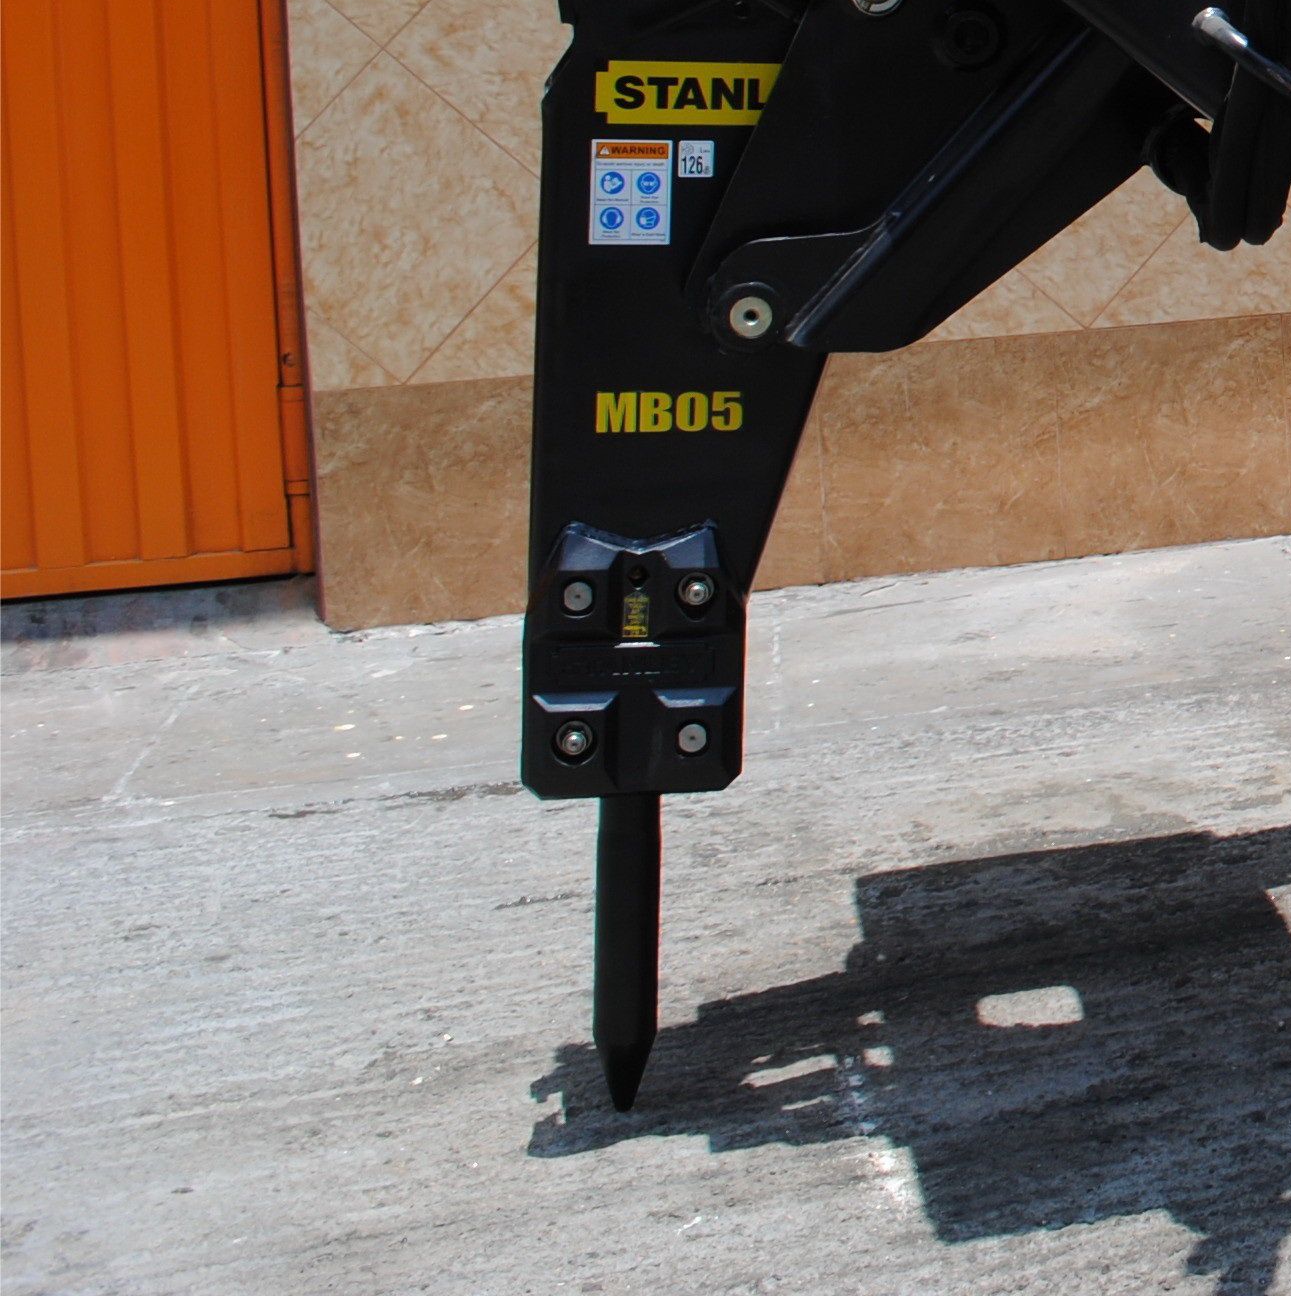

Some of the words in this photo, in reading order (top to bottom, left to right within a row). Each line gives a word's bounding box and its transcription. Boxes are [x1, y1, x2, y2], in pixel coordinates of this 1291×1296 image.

[611, 145, 666, 155] WARNING
[681, 155, 704, 174] 126
[595, 390, 744, 434] MB05
